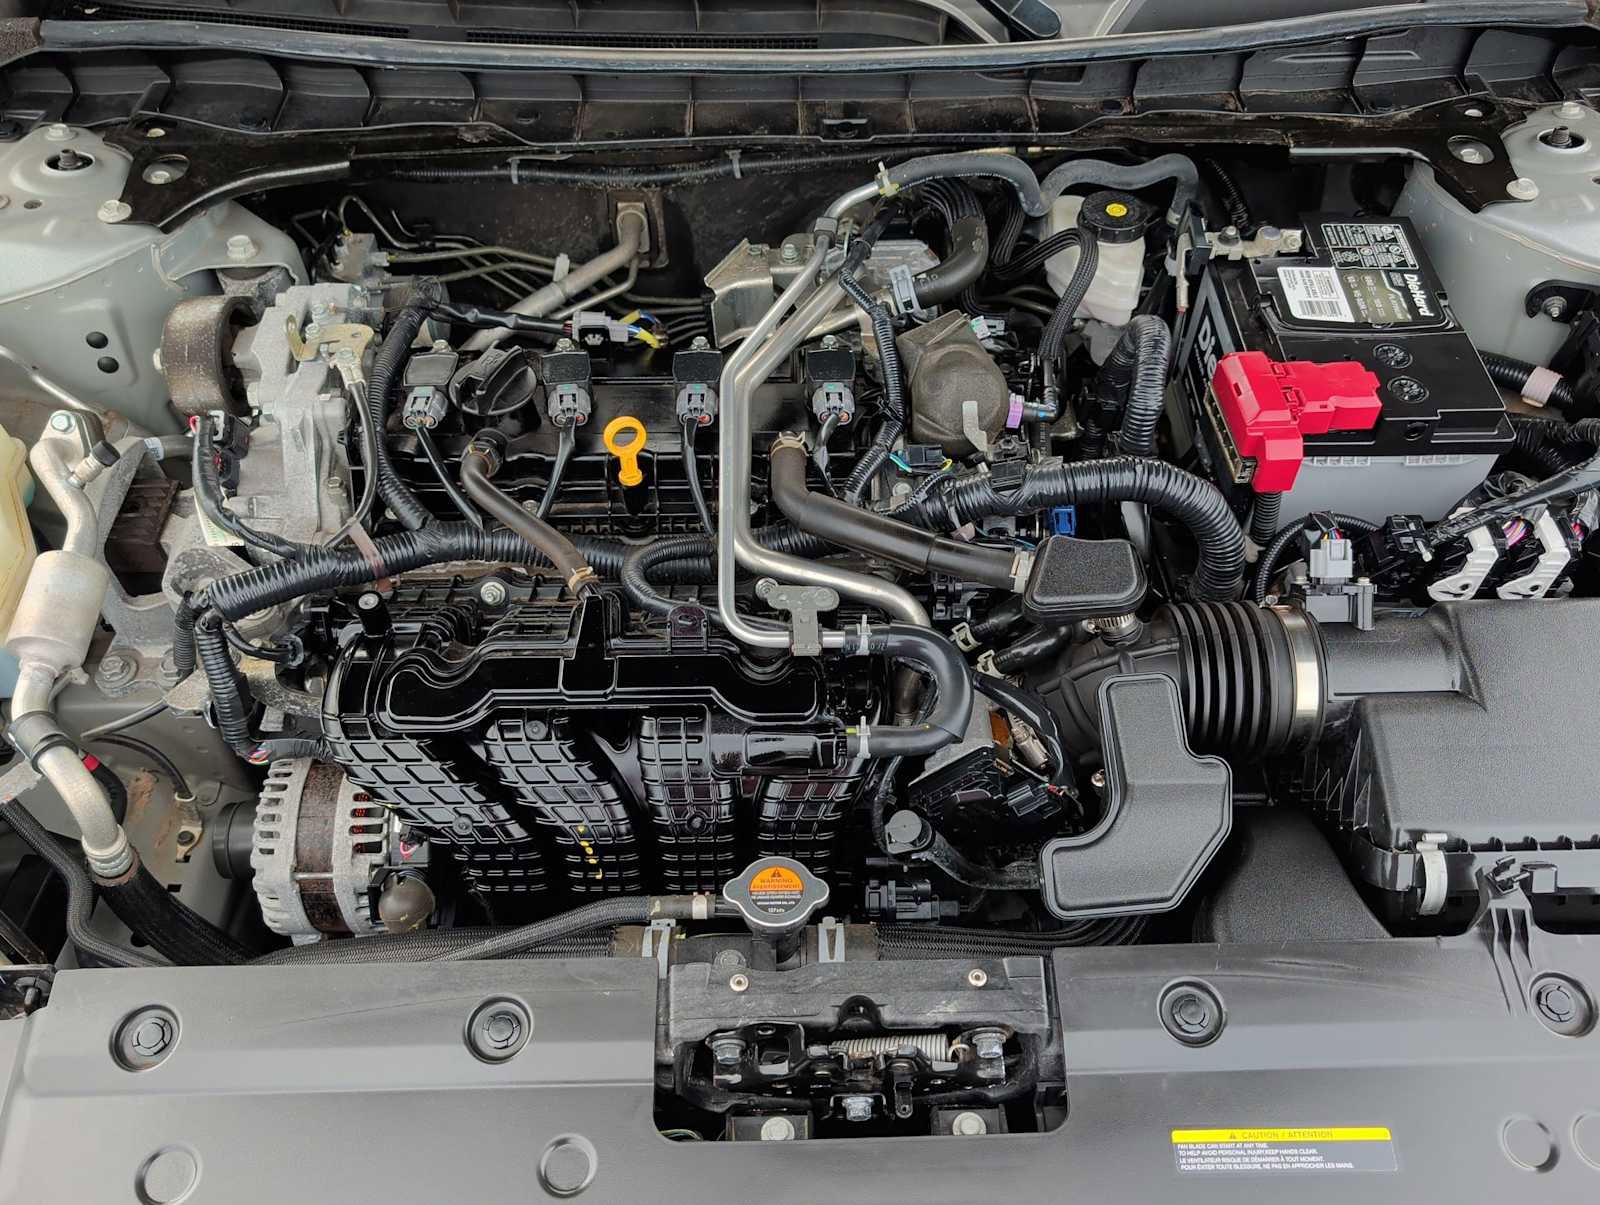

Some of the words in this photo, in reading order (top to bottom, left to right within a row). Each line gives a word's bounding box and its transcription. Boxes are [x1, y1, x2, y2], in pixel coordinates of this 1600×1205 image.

[1403, 273, 1435, 317] DieHard
[1241, 1131, 1279, 1139] CAUTION
[1288, 1130, 1333, 1138] ATTENTION
